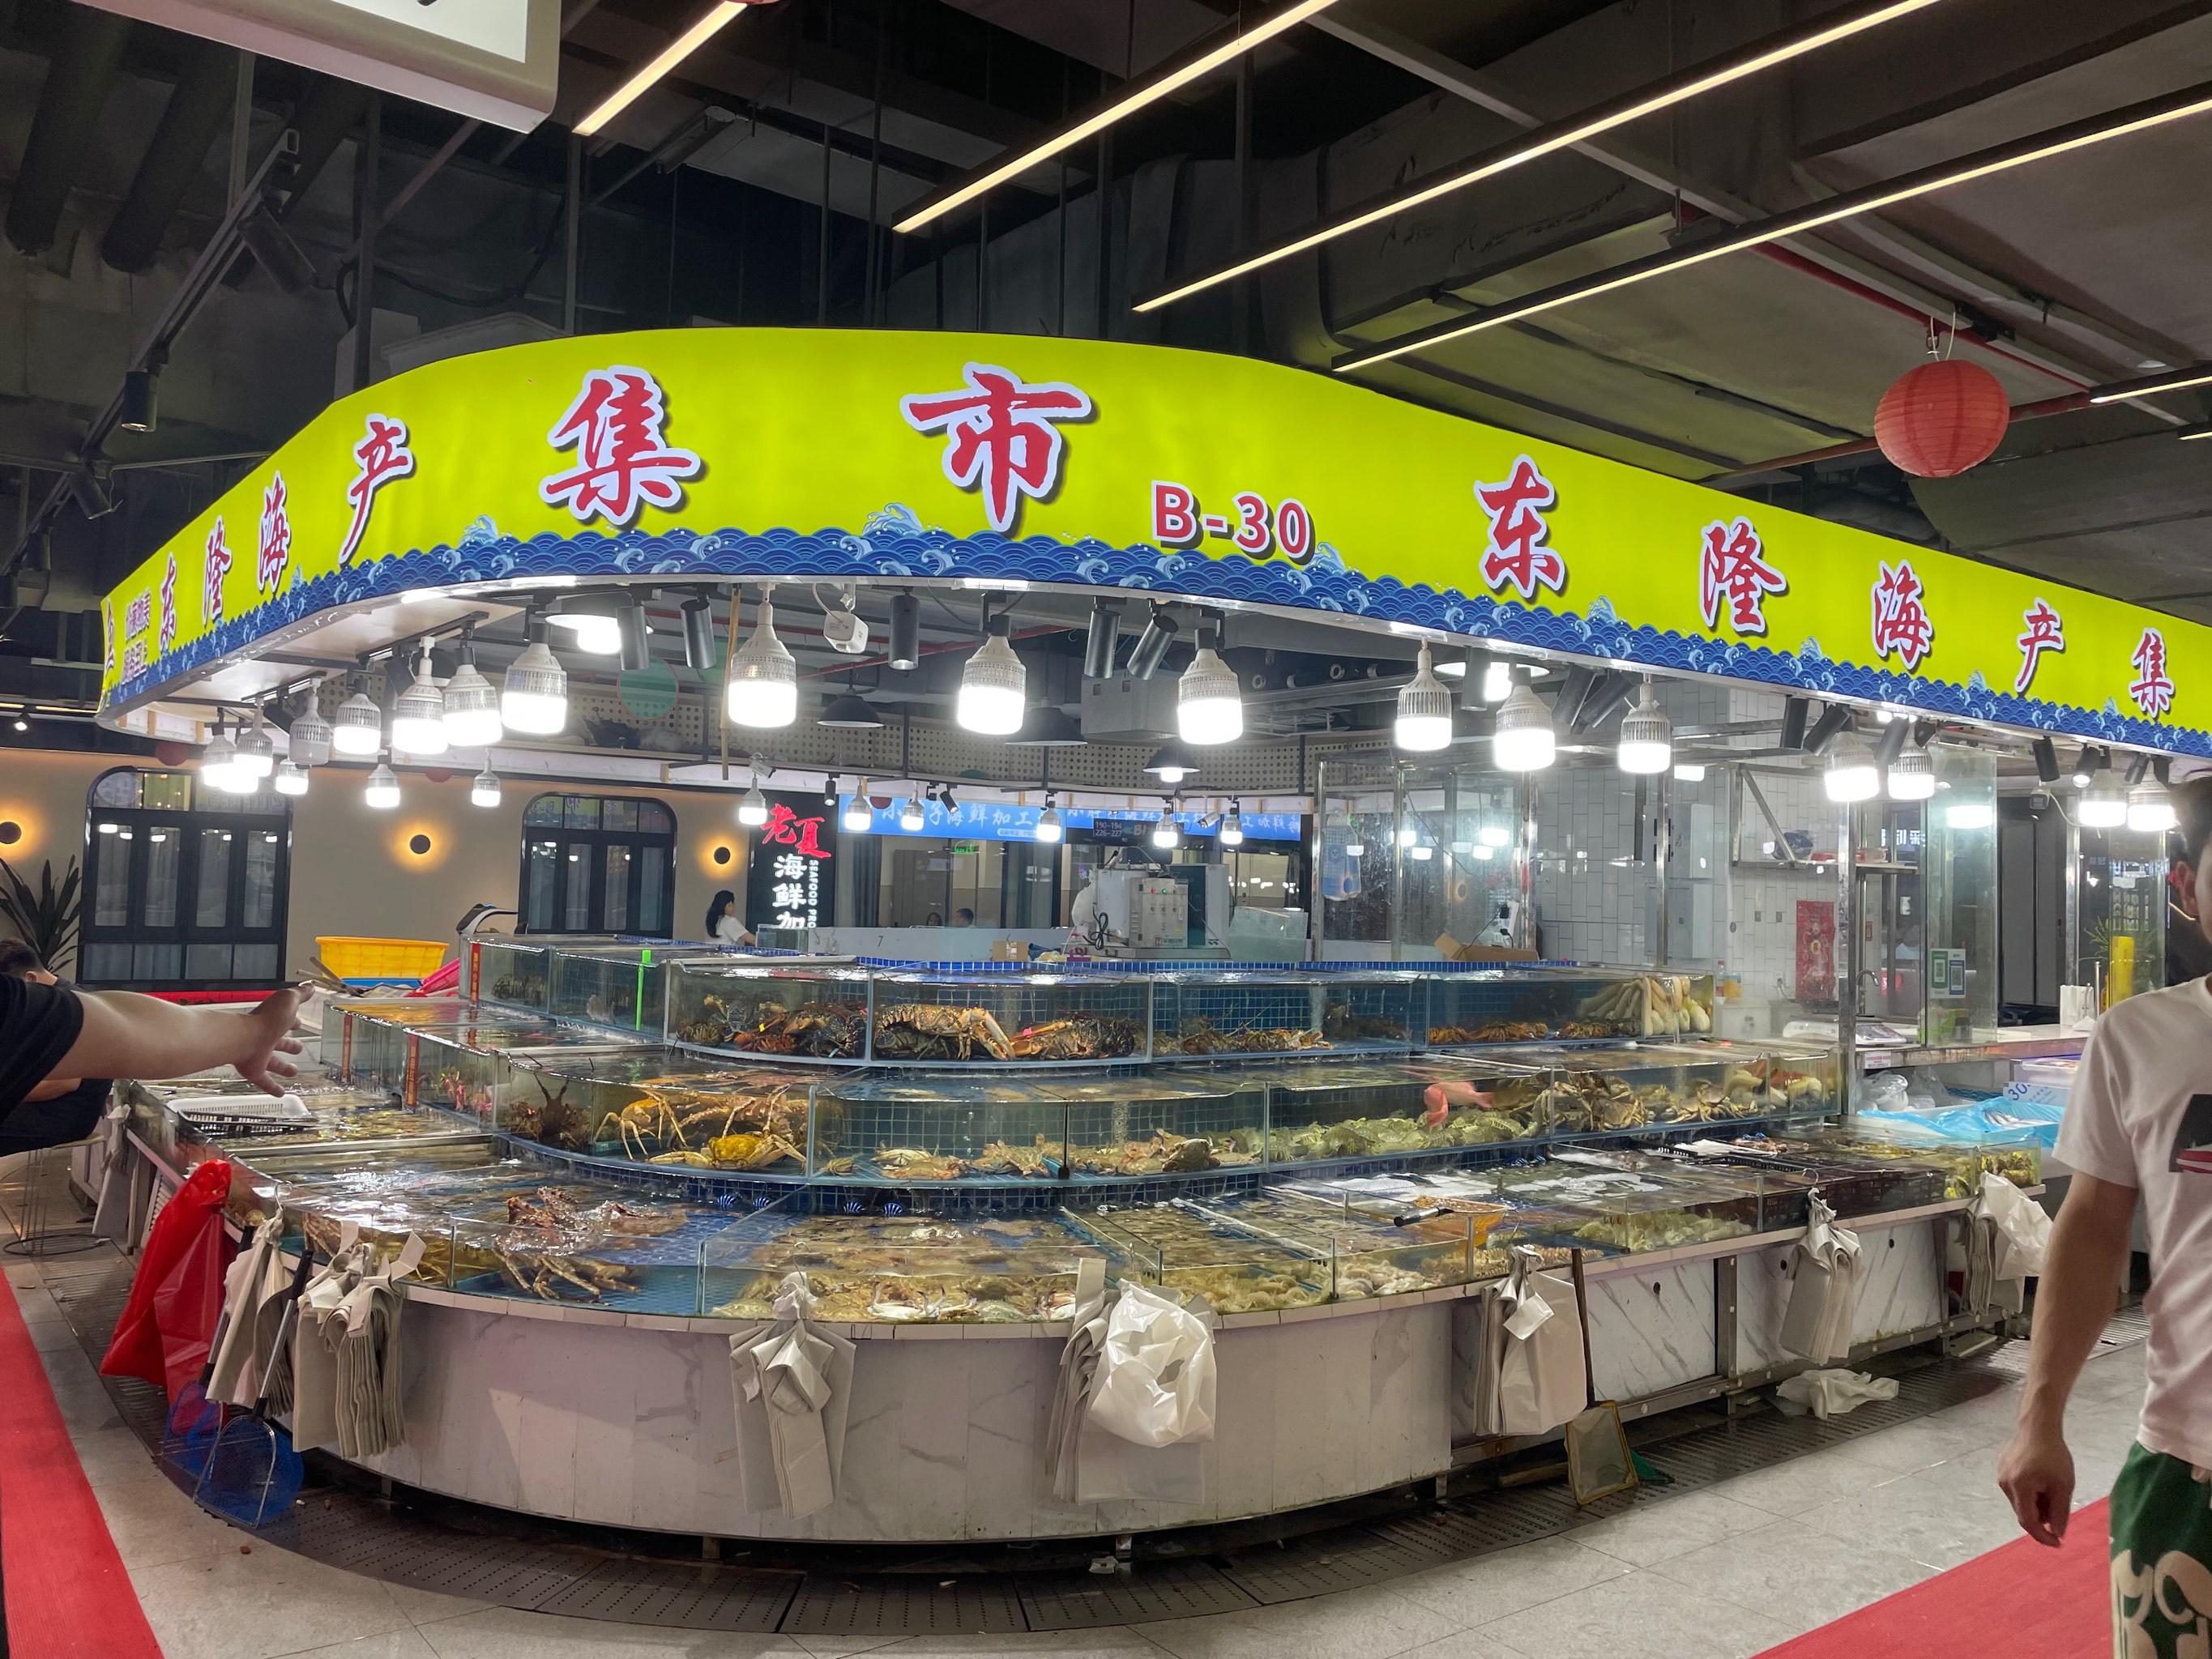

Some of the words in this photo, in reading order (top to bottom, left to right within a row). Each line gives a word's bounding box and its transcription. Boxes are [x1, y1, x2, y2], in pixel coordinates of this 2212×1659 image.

[1153, 480, 1310, 559] B-30
[760, 803, 833, 859] 老夏
[882, 801, 1046, 830] 小子海鲜加工
[808, 859, 819, 906] SEAFOOD
